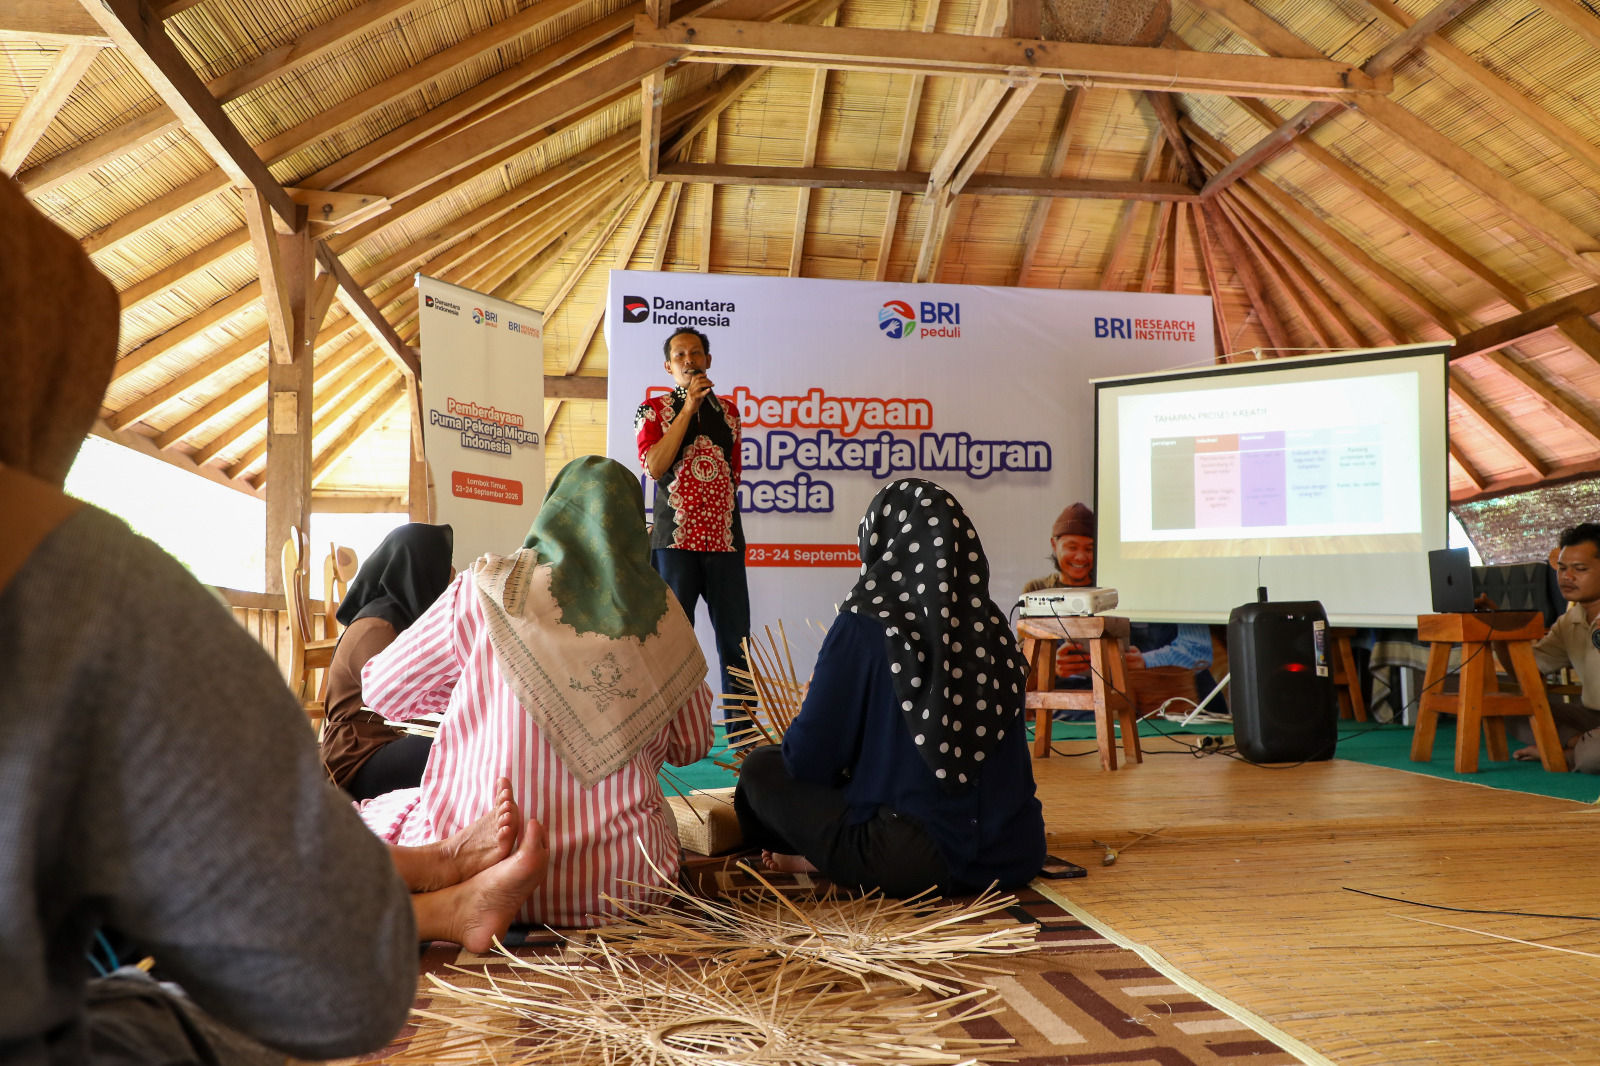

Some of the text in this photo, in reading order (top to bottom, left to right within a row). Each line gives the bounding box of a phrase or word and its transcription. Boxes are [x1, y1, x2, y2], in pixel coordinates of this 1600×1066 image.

[653, 296, 735, 312] Danantara
[485, 310, 498, 323] BRI
[652, 311, 730, 327] Indonesia
[920, 301, 960, 324] BRI
[508, 321, 521, 333] BRI
[1094, 317, 1132, 339] BRI
[1135, 318, 1195, 330] RESEARCH
[920, 326, 960, 339] peduli
[1135, 330, 1196, 342] INSTITUTE
[447, 397, 524, 427] Pemberdayaan
[646, 386, 932, 437] berdayaan
[430, 409, 539, 445] Purna Pekerja Migran
[461, 432, 512, 455] Indonesia
[766, 431, 915, 479] Pekerja
[919, 432, 1052, 479] Migran
[467, 478, 489, 488] Lombok
[474, 487, 504, 498] September
[642, 473, 834, 513] Inesia
[749, 549, 861, 565] 23-24 Septemb
